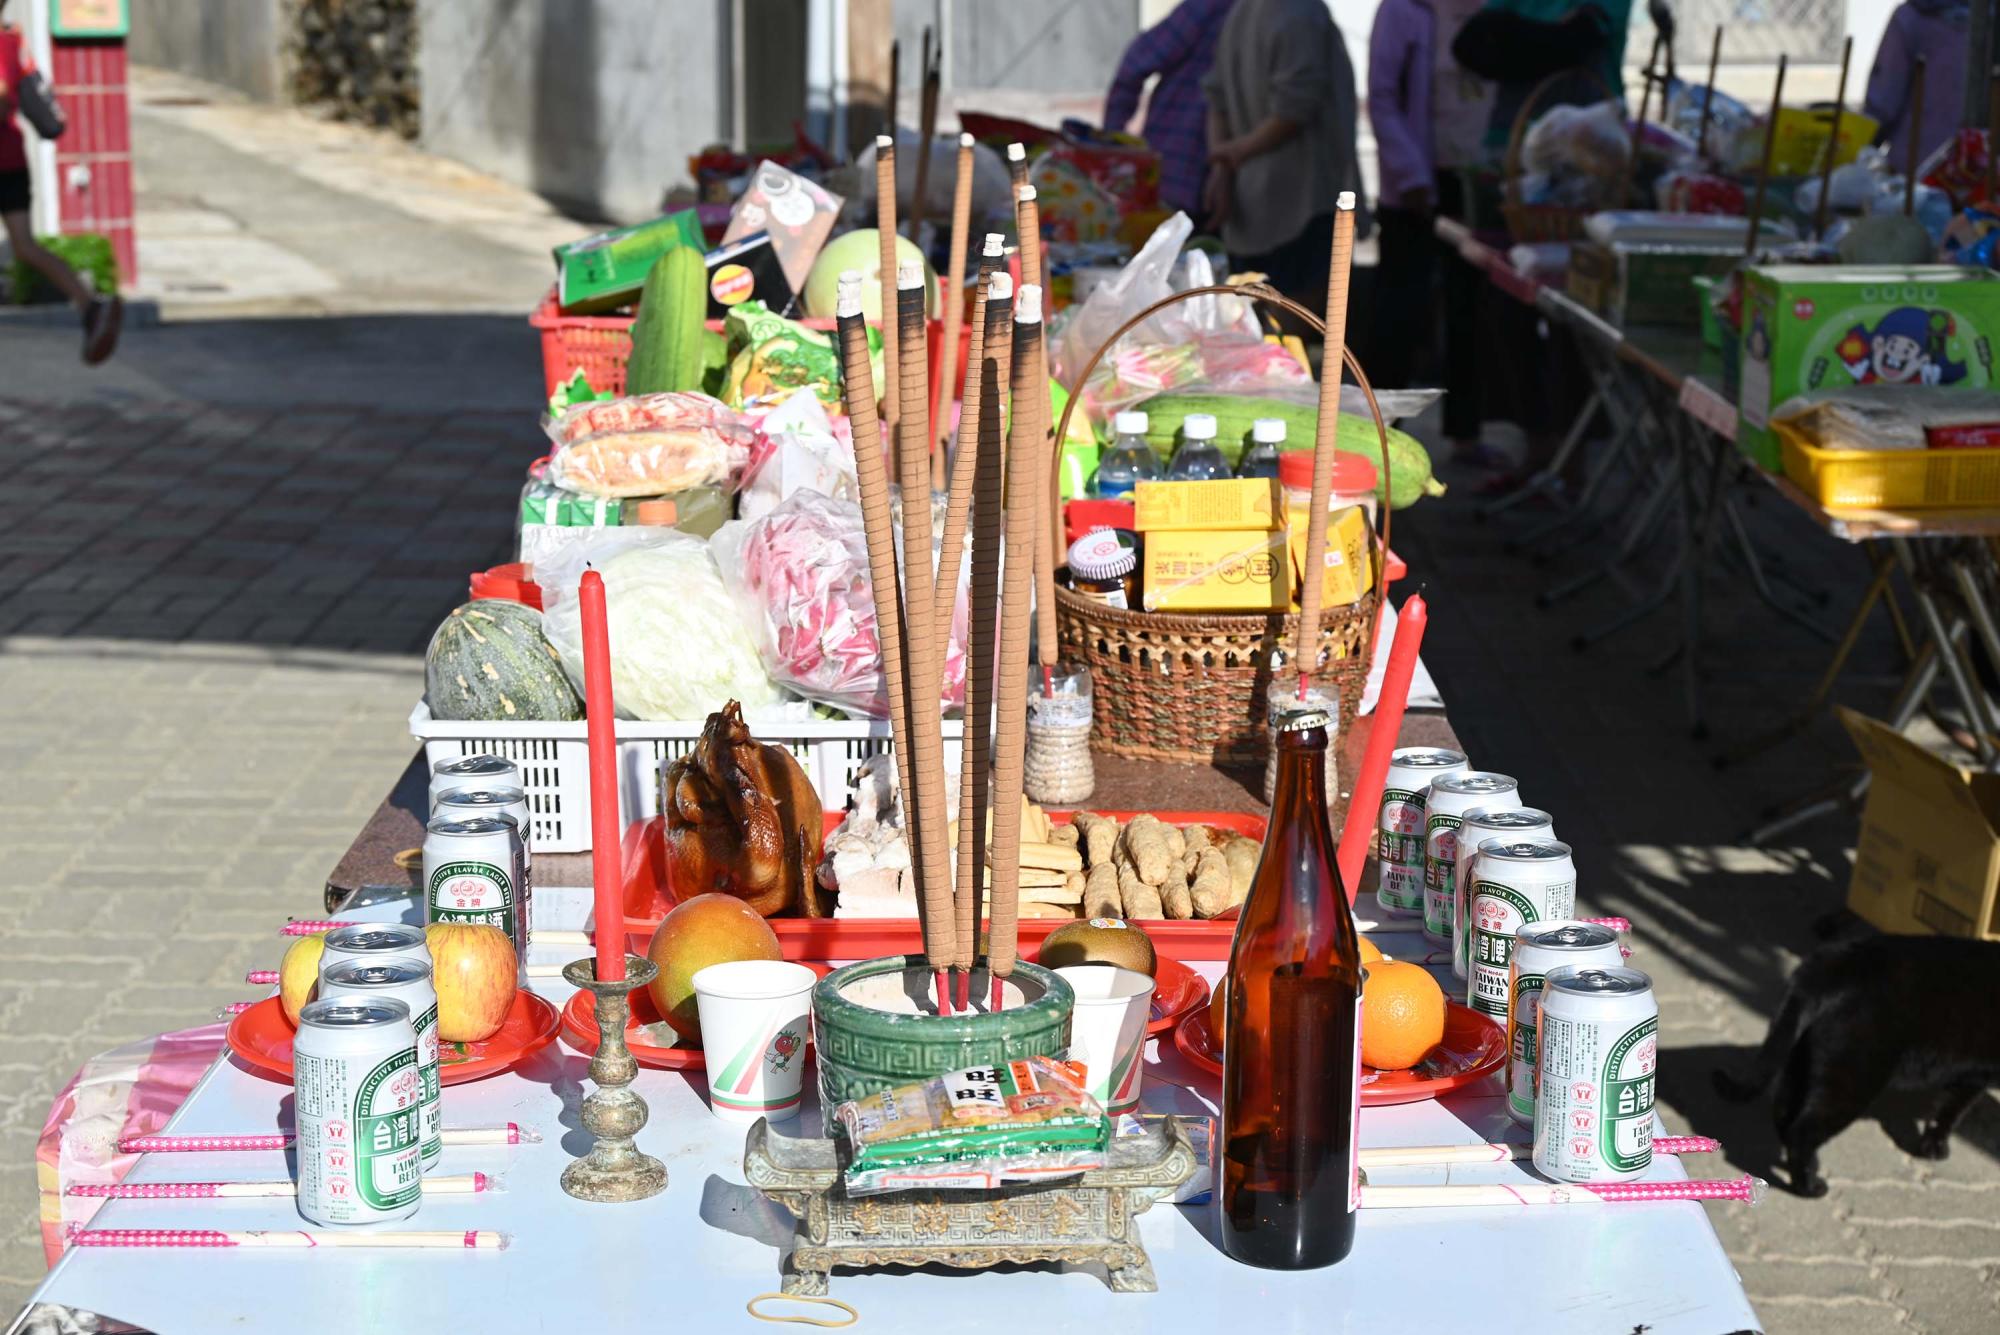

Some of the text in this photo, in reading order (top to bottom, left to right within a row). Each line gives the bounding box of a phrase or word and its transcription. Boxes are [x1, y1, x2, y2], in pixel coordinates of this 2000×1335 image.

[1440, 818, 1460, 829] FLAVO
[431, 865, 512, 905] DISTINCTIVE FLAVOR LAGER BEER
[456, 897, 481, 908] 金牌
[1481, 887, 1507, 898] FLAVOR
[1509, 894, 1530, 916] LAGER
[1481, 918, 1503, 931] 金牌
[1474, 970, 1509, 988] TAIWAN
[1477, 981, 1505, 998] BEER
[1609, 1032, 1641, 1080] DISTINCTIVE
[361, 1065, 393, 1116] DISTINCTIVE
[955, 1068, 1008, 1105] 旺旺
